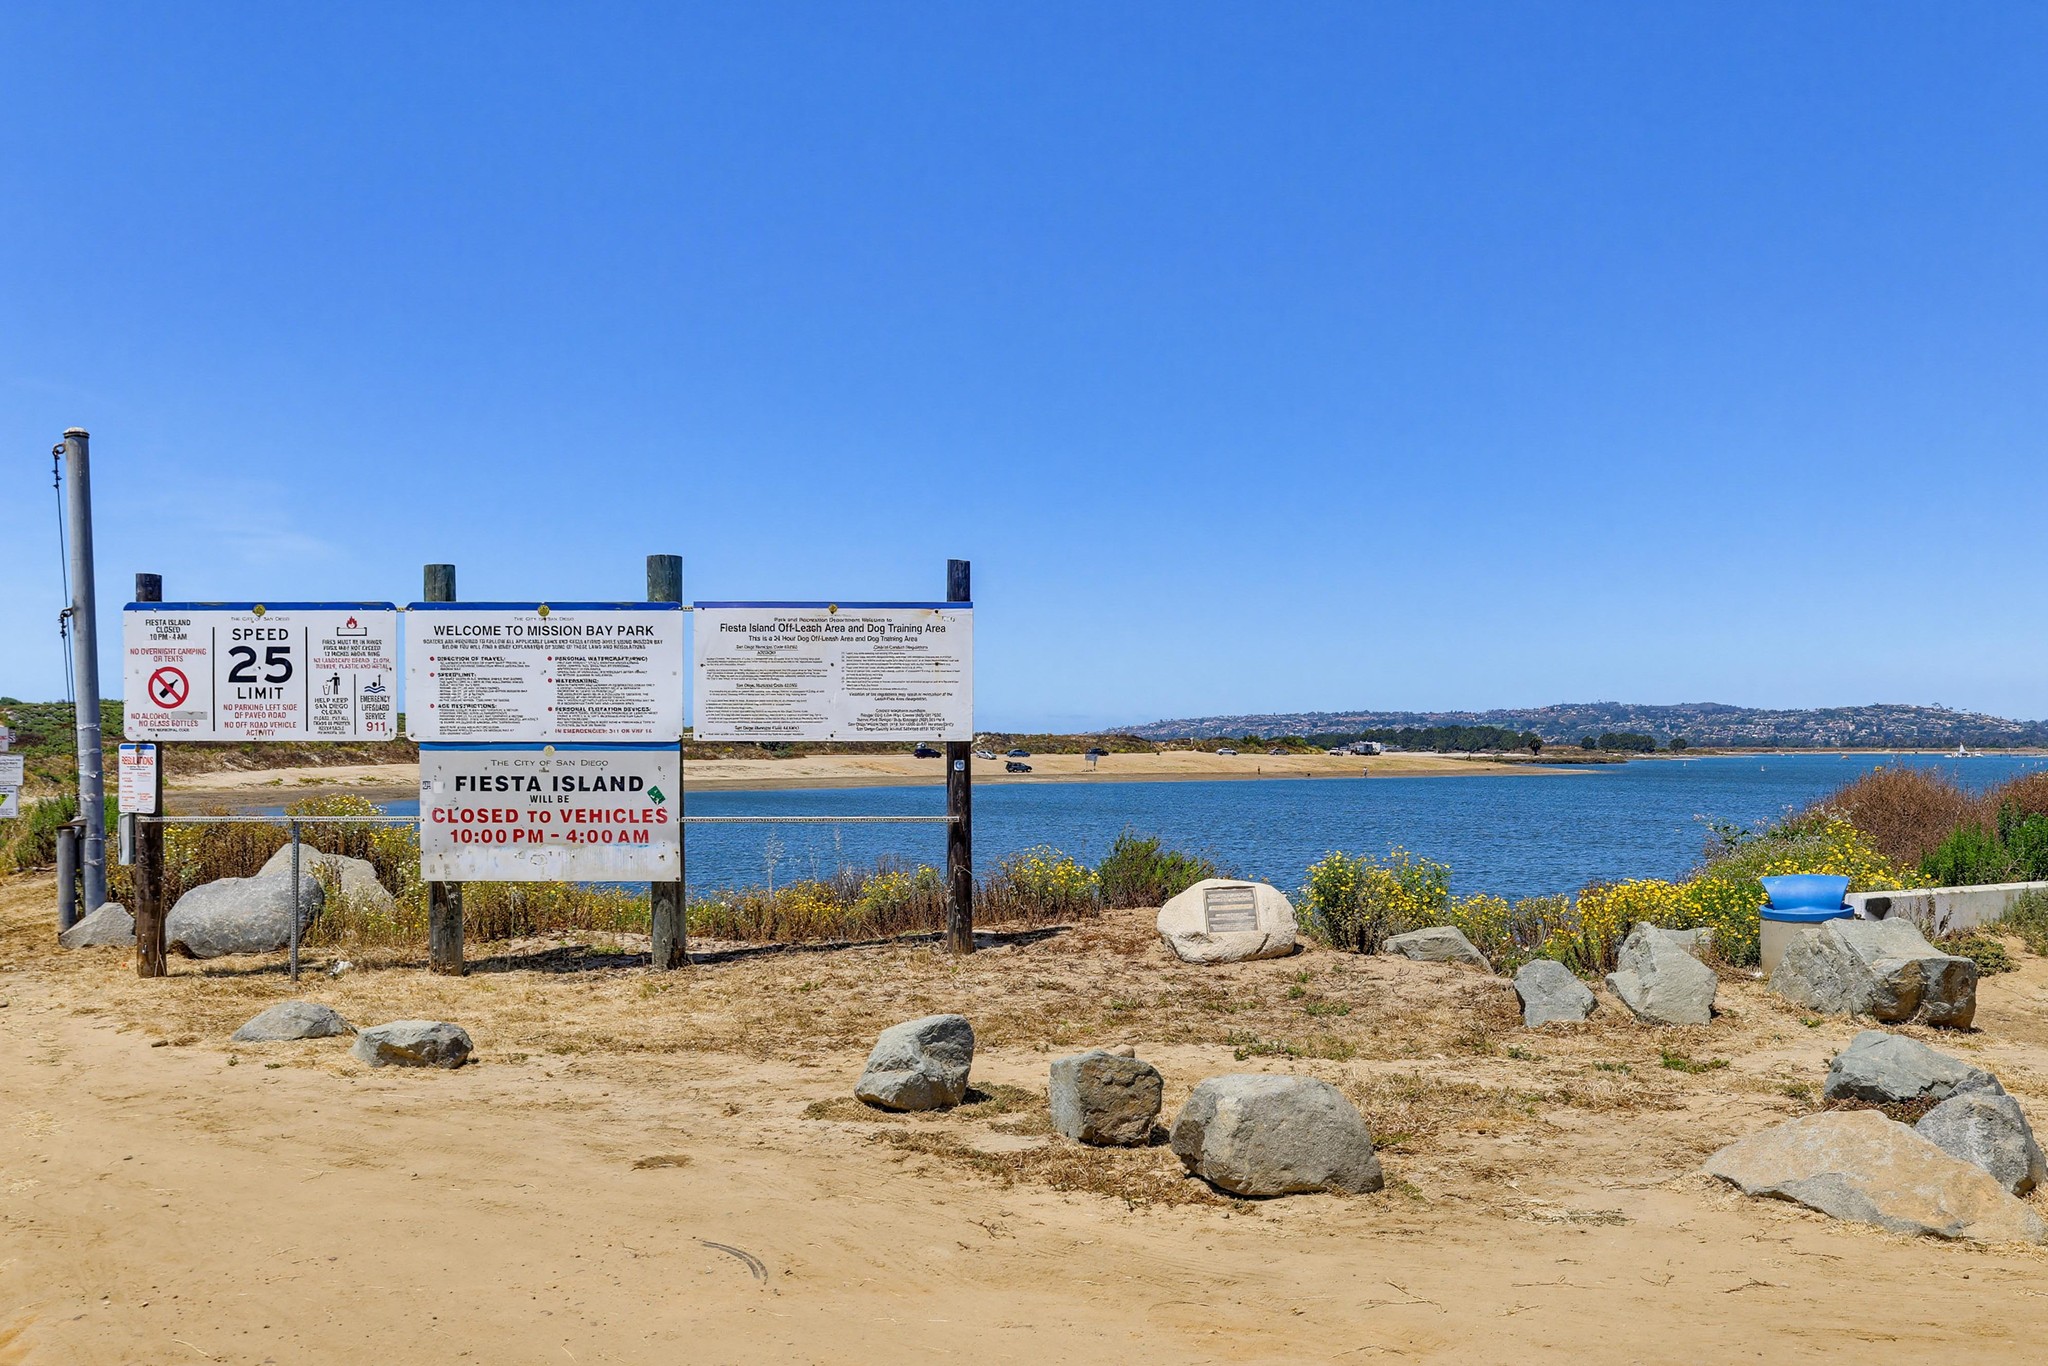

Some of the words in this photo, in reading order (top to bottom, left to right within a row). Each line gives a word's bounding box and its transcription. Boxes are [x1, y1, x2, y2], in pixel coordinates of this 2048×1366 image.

[232, 628, 288, 640] SPEED
[434, 625, 501, 636] WELCOME
[505, 625, 523, 636] TO
[527, 625, 582, 636] MISSION
[586, 625, 613, 636] BAY
[617, 625, 654, 636] PARK
[720, 624, 746, 632] Fiesta
[749, 624, 775, 632] Island
[778, 624, 822, 632] Off-Leash
[825, 624, 845, 632] Area
[848, 624, 864, 632] and
[867, 624, 885, 634] Dog
[888, 624, 922, 634] Training
[925, 624, 946, 632] Area
[228, 646, 293, 684] 25
[238, 687, 283, 700] LIMIT
[366, 722, 386, 732] 911
[455, 776, 541, 792] FIESTA
[553, 776, 644, 792] ISLAND
[530, 795, 553, 804] WILL
[557, 795, 570, 804] BE
[432, 808, 519, 824] CLOSED
[528, 810, 551, 823] TO
[560, 808, 668, 824] VEHICLES
[451, 829, 506, 843] 10:00
[513, 829, 544, 843] PM
[566, 829, 612, 843] 4:00
[618, 829, 649, 843] AM
